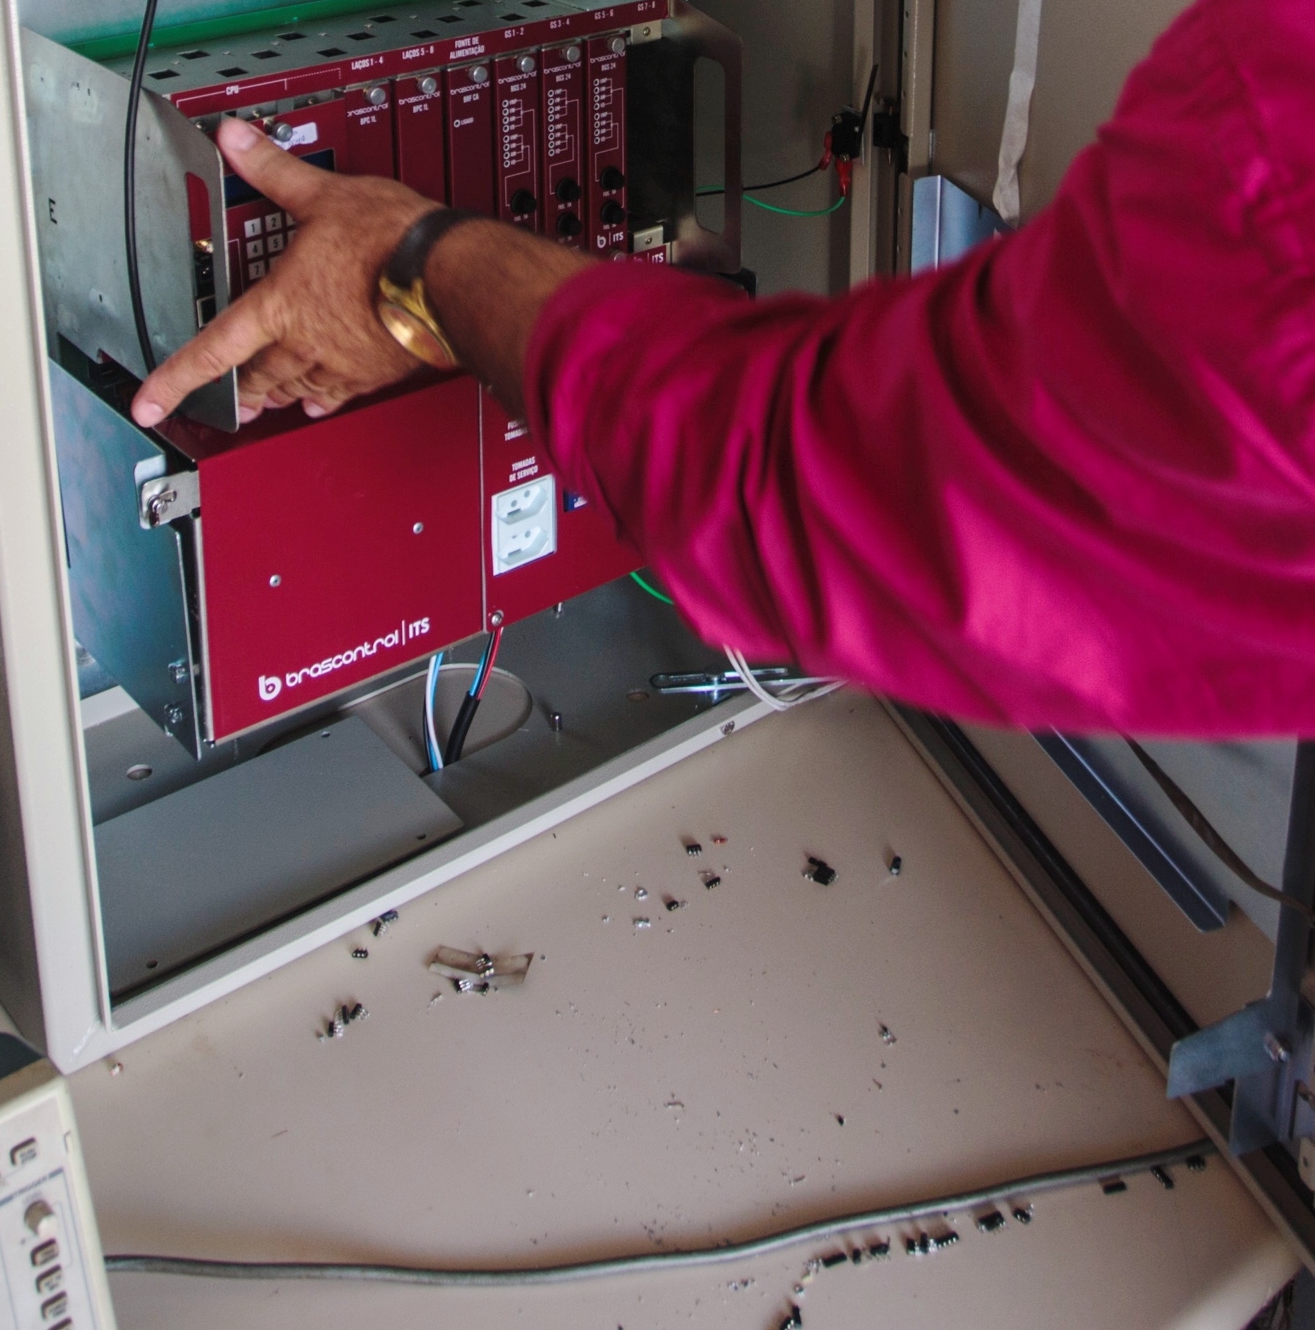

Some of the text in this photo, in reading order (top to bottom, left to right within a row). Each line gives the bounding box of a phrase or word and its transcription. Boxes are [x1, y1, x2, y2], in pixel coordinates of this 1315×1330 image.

[455, 36, 479, 48] FONTE DE
[402, 48, 420, 60] LAÇOS
[449, 45, 485, 59] ALIMENTAÇÃO
[351, 59, 370, 70] LAÇOS
[543, 61, 582, 75] brascontrol
[498, 71, 537, 85] brascontrol
[226, 85, 239, 95] CPU
[450, 81, 490, 95] brascontrol
[399, 91, 440, 105] brascontrol
[612, 232, 624, 242] ITS
[651, 252, 664, 264] ITS
[512, 456, 536, 471] TOMADAS
[509, 465, 539, 483] DE SERVIÇO
[285, 629, 399, 687] brascontrol
[408, 617, 430, 639] ITS
